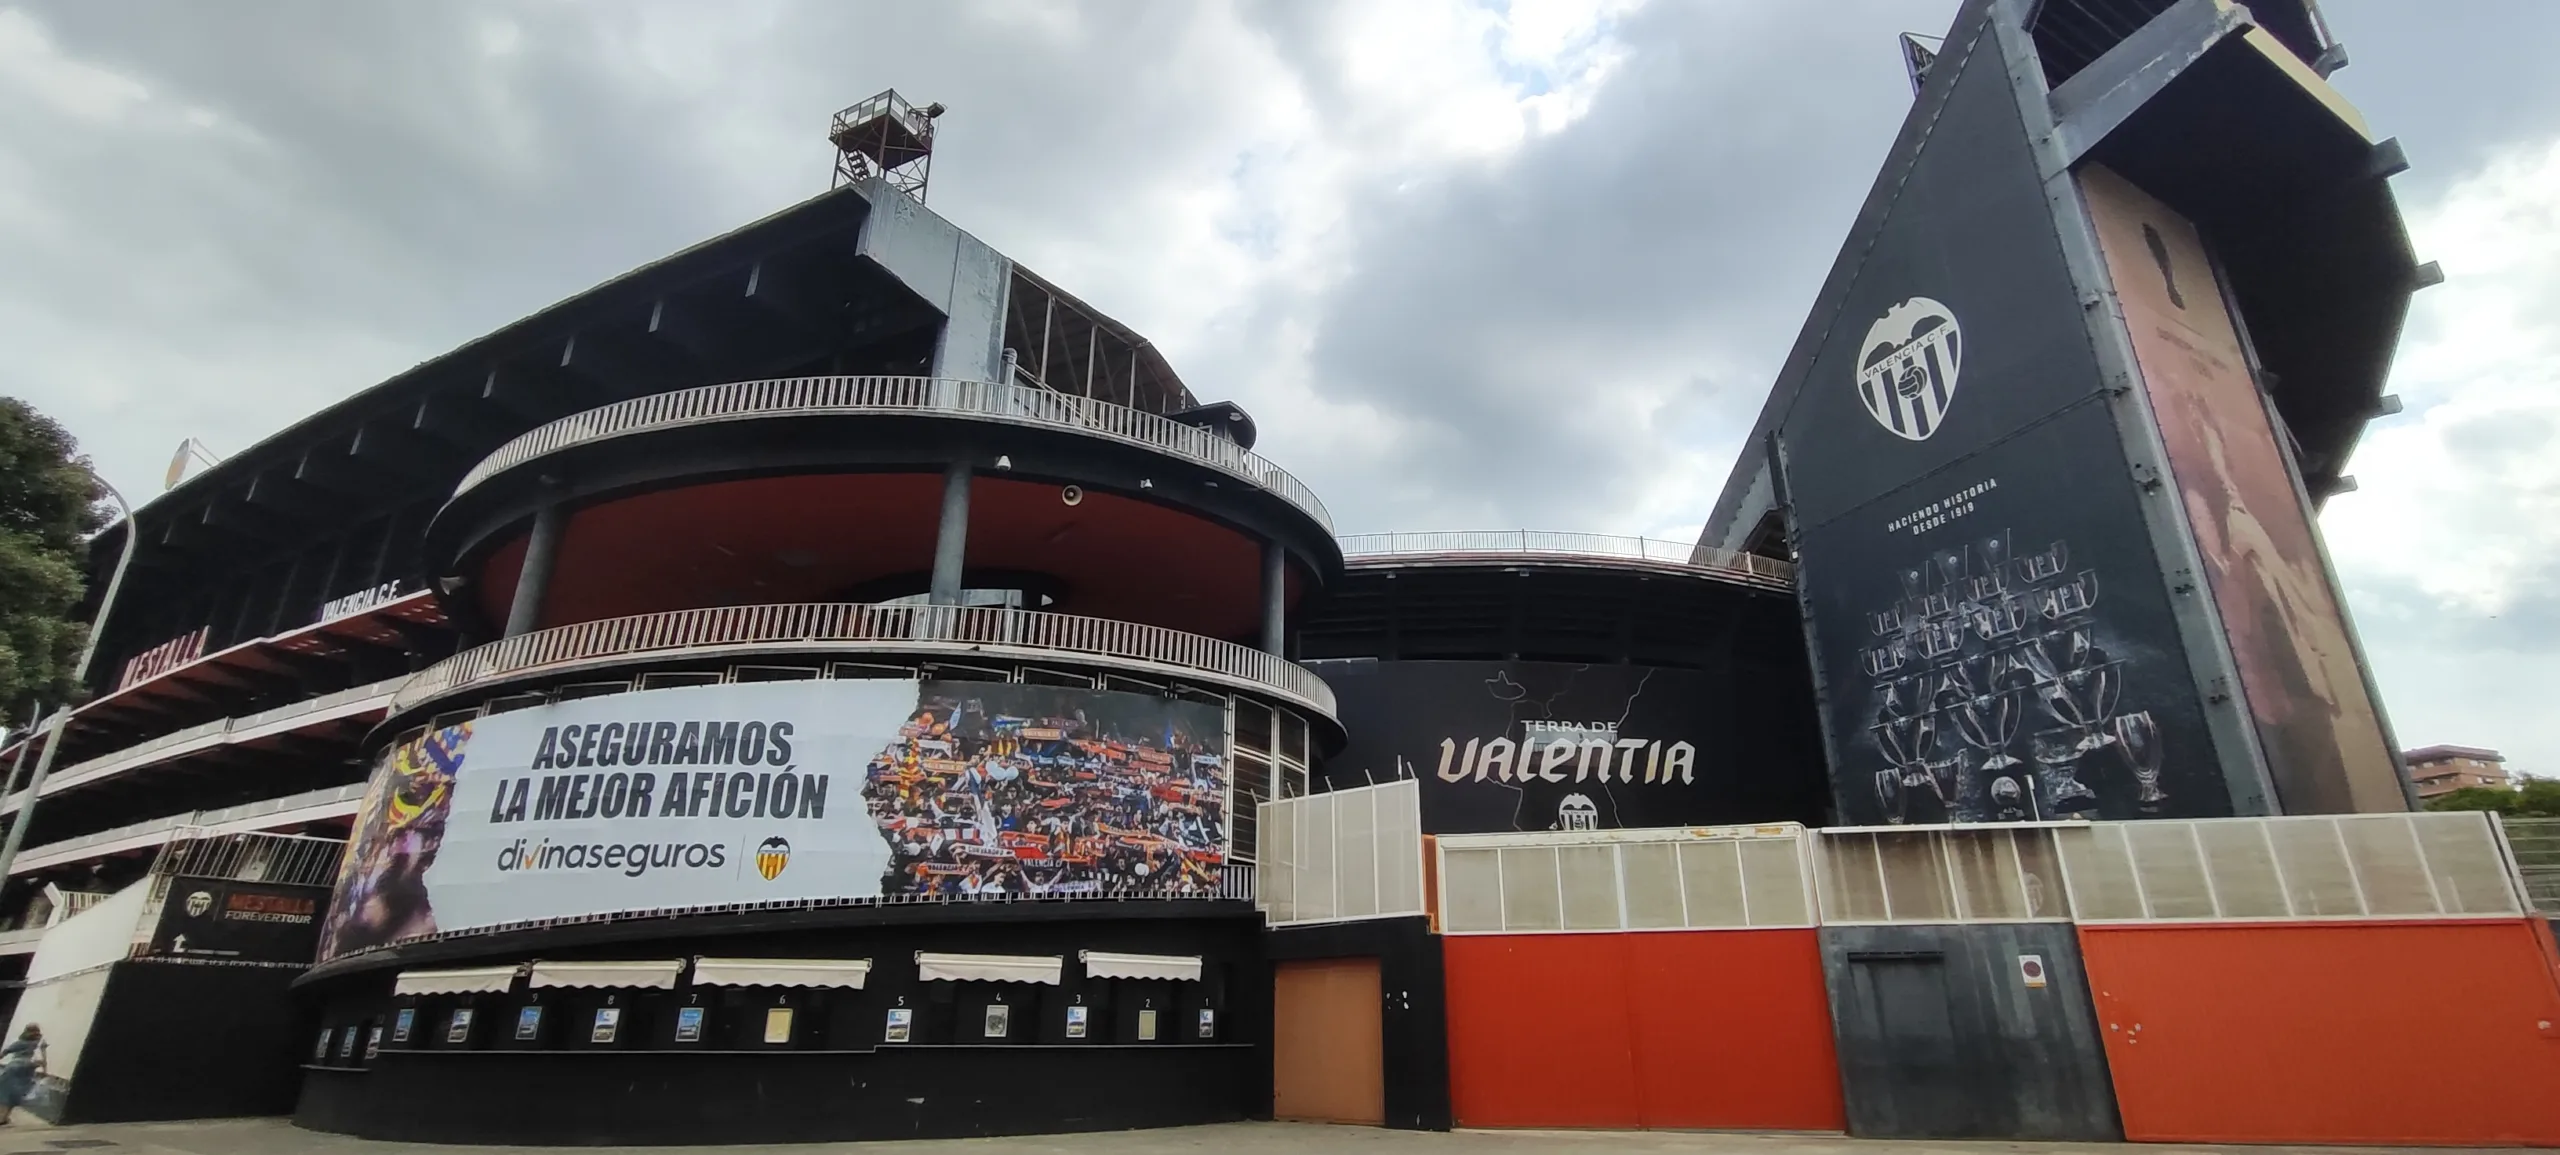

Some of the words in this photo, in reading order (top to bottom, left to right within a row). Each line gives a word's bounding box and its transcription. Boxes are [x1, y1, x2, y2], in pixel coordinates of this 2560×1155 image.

[1864, 341, 1924, 378] VALENCIA
[1888, 503, 1939, 533] HACIENDO
[1943, 478, 1998, 508] HISTORIA
[1912, 513, 1946, 535] DESDE
[1950, 501, 1975, 519] 1919
[321, 584, 375, 623] VALENCIA
[119, 624, 211, 691] MESTALLA
[1521, 719, 1588, 733] TERRA
[1591, 721, 1618, 733] DE
[531, 721, 795, 770] ASEGURAMOS
[489, 777, 530, 823] LA
[533, 772, 656, 821] MEJOR
[659, 765, 829, 820] AFICIÓN
[497, 838, 725, 877] divinaseguros
[224, 910, 312, 924] FOREVERTOUR
[532, 992, 539, 1003] 9
[607, 994, 615, 1005] 8
[691, 993, 698, 1004] 7
[779, 994, 786, 1005] 6
[898, 995, 904, 1007] 5
[995, 992, 1002, 1002] 4
[1075, 994, 1082, 1004] 3
[1145, 998, 1151, 1008] 2
[1205, 997, 1209, 1007] 1
